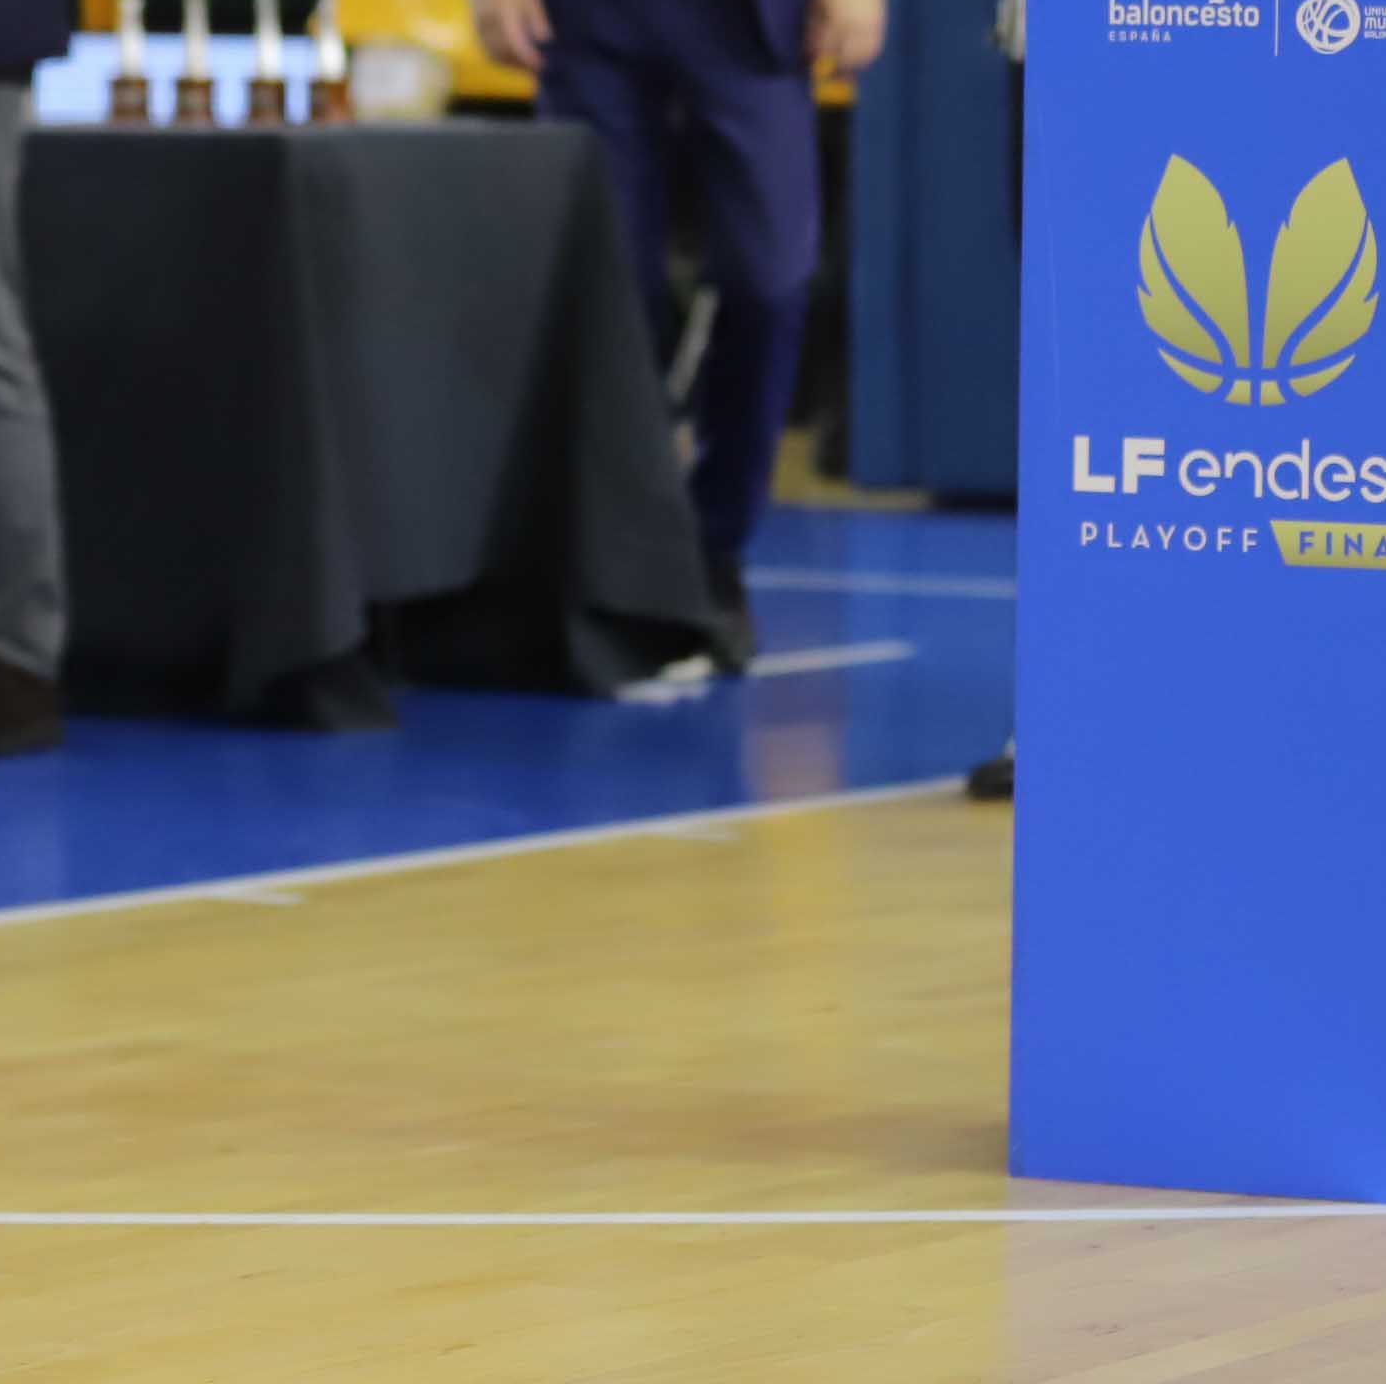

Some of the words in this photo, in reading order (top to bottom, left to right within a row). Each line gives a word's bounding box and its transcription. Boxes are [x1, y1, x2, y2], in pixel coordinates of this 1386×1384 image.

[1108, 30, 1172, 43] ESPAÑA
[1072, 435, 1165, 494] LF
[1080, 521, 1259, 553] PLAYOFF
